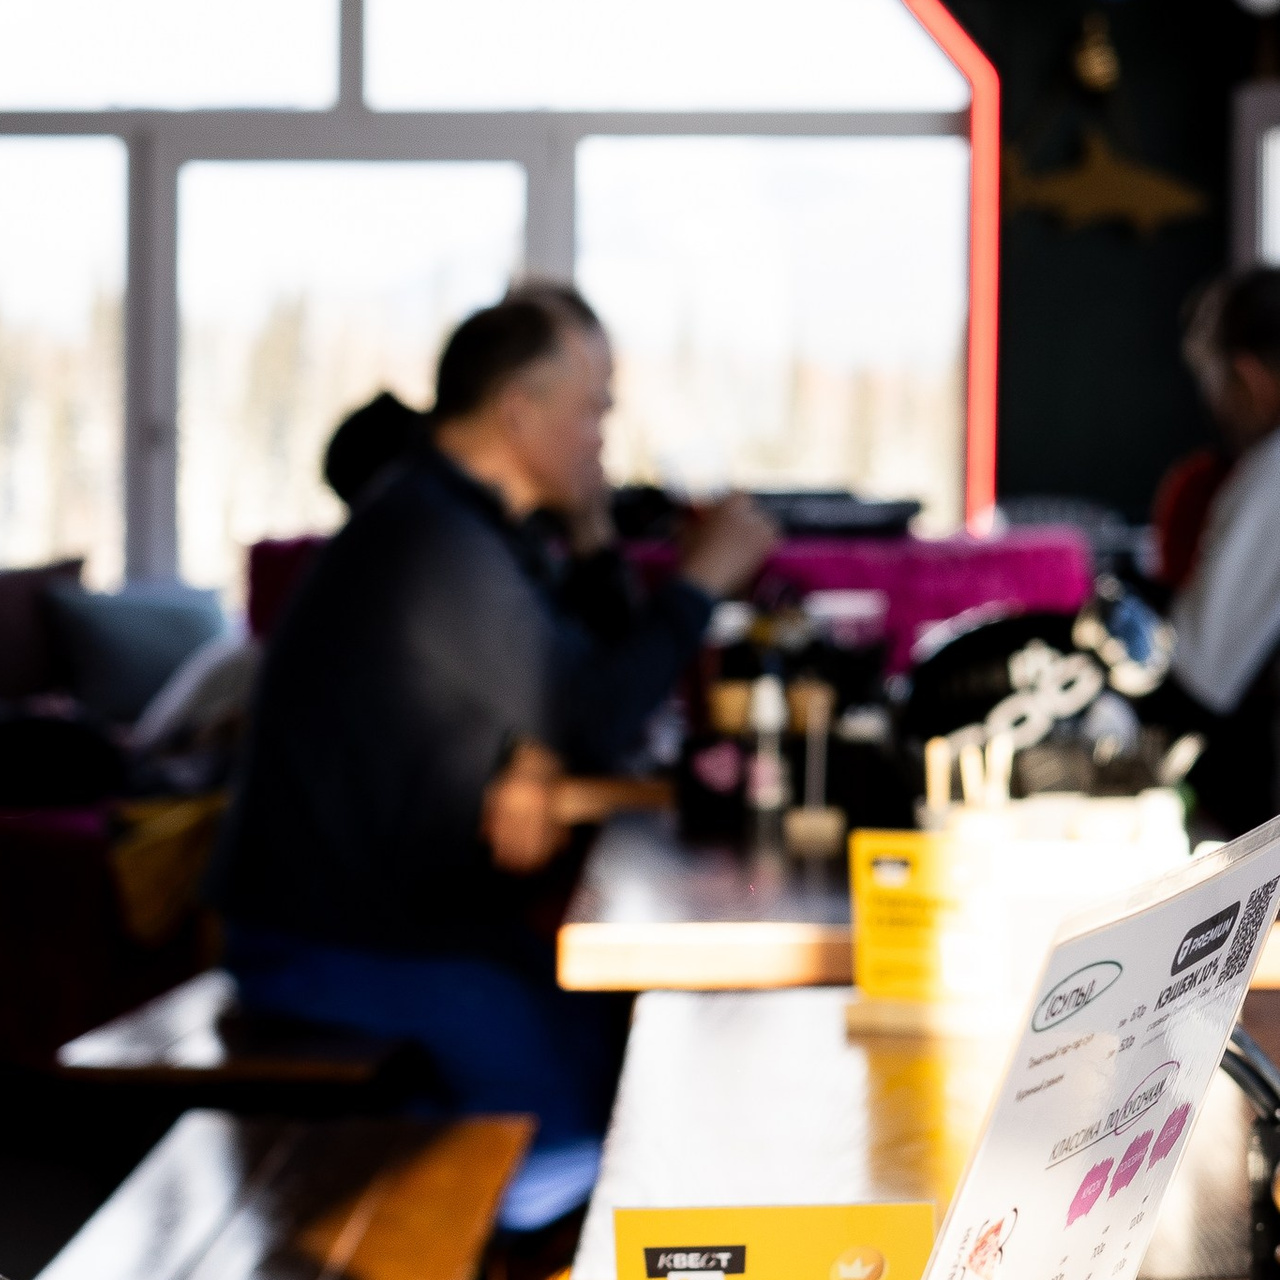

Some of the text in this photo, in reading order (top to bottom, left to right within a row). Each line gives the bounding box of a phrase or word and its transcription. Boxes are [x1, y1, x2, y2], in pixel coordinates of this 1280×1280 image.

[1190, 915, 1234, 955] PREMIUM
[1154, 969, 1200, 1011] КЭШБЭК
[1197, 953, 1222, 987] 10%
[1049, 1121, 1102, 1162] КЛАССИКА
